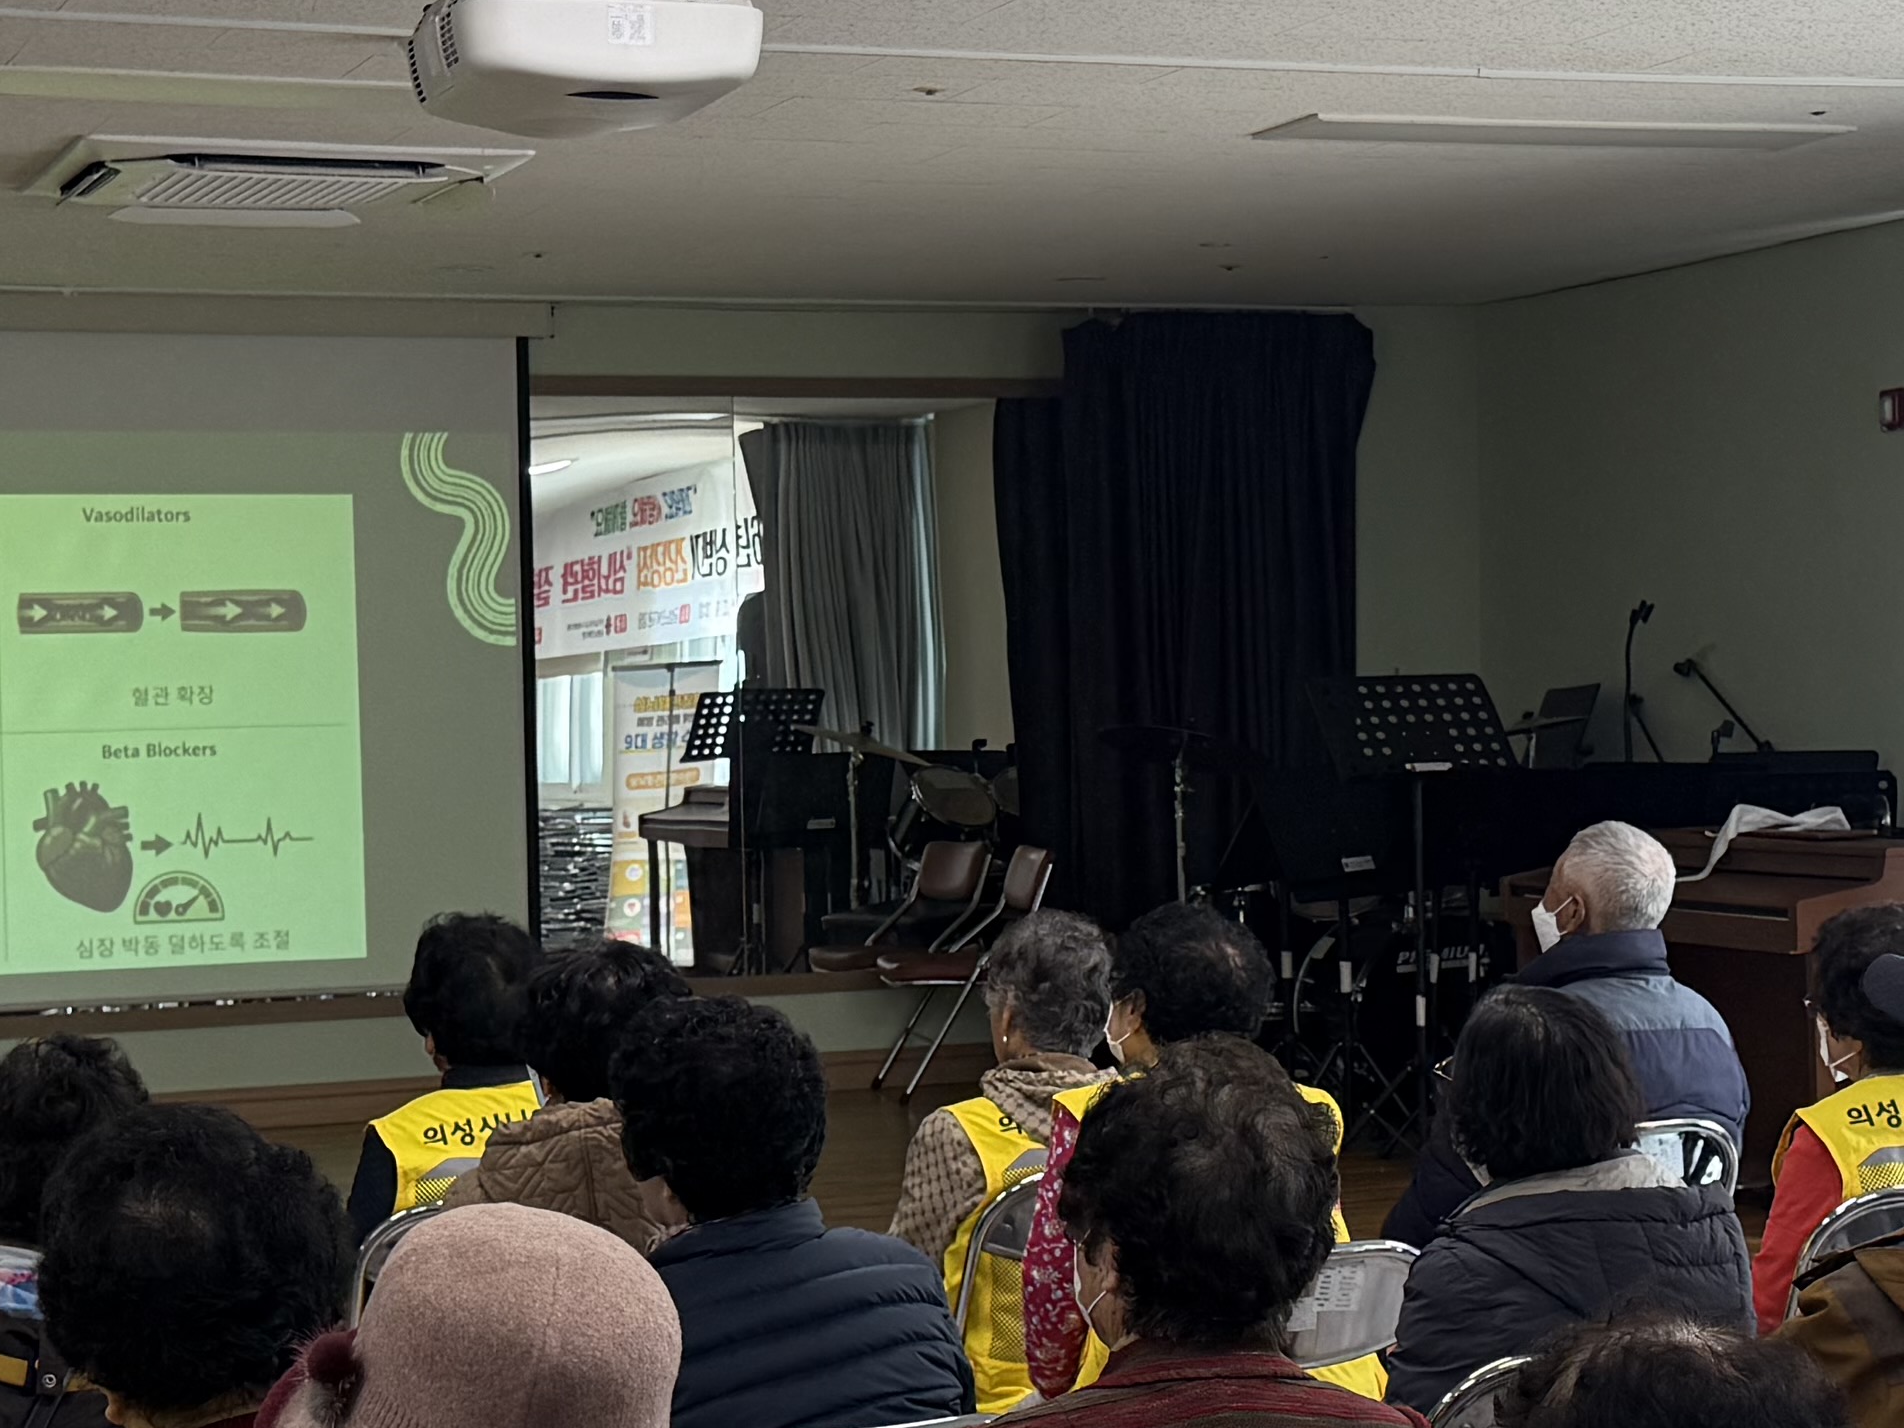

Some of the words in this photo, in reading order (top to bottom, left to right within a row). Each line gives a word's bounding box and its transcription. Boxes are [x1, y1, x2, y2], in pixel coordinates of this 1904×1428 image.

[82, 506, 191, 524] Vasodilators
[132, 685, 171, 707] 혈관
[176, 684, 214, 706] 확장
[102, 743, 140, 760] Beta
[146, 741, 217, 759] Blockers
[76, 937, 115, 959] 심장
[122, 935, 160, 956] 박동
[168, 931, 246, 955] 덜하도록
[252, 929, 290, 951] 조절
